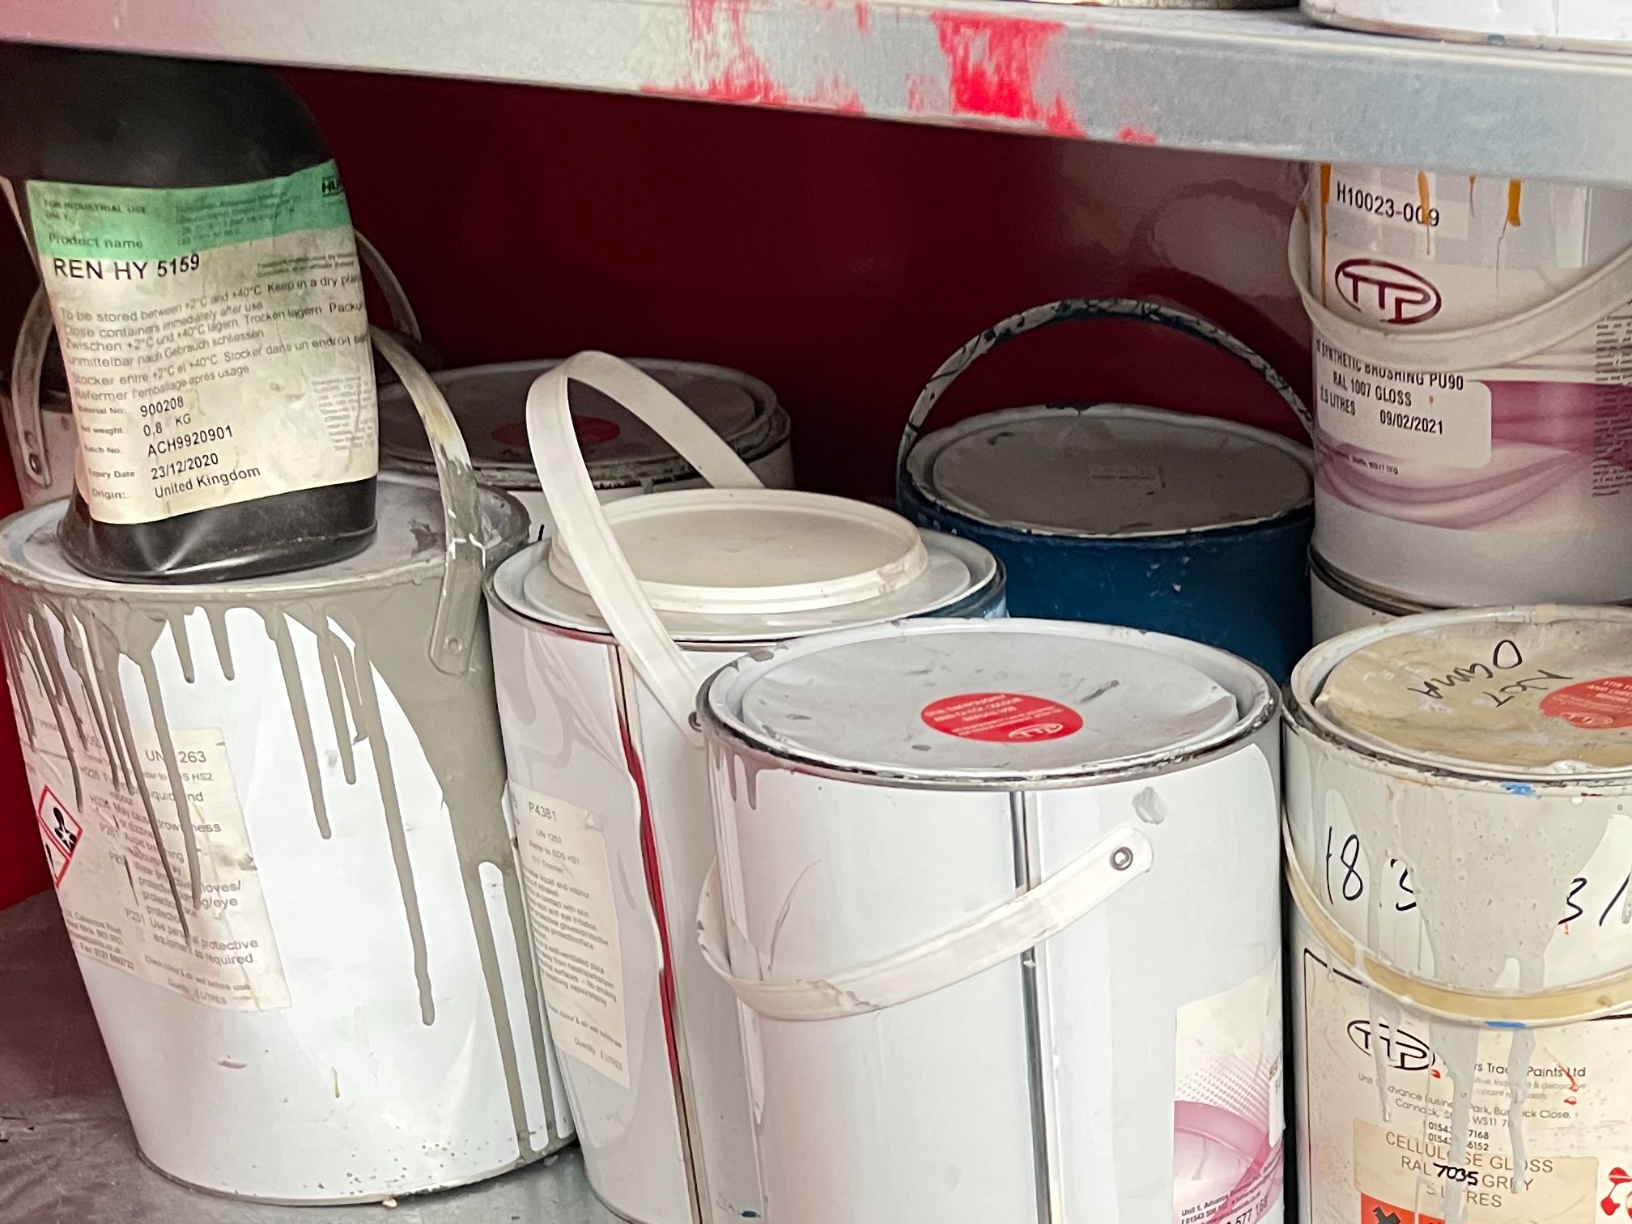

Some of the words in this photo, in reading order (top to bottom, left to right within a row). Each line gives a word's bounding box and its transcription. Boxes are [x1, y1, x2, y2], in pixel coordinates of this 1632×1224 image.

[49, 234, 102, 248] Product
[106, 239, 143, 249] name
[54, 258, 104, 279] REN
[115, 261, 148, 280] HY
[157, 253, 200, 277] 5159
[97, 312, 138, 321] stored
[141, 305, 182, 320] between
[211, 292, 229, 302] and
[268, 282, 295, 294] Keep
[297, 280, 307, 289] in
[320, 276, 337, 287] dry
[1340, 264, 1436, 323] TTP
[100, 322, 160, 338] containers
[221, 305, 242, 317] after
[244, 311, 285, 325] Trocken
[1333, 371, 1347, 391] RAL
[1351, 379, 1371, 398] 1007
[1375, 385, 1412, 407] GLOSS
[1429, 373, 1464, 391] PU90
[140, 395, 184, 417] 900208
[1330, 394, 1356, 416] LITRES
[175, 413, 192, 427] KG
[1380, 409, 1443, 435] 09/02/2021
[147, 425, 233, 458] ACH9920901
[151, 453, 219, 480] 23/12/2020
[155, 479, 193, 499] United
[197, 467, 262, 486] Kingdom
[1401, 1156, 1432, 1177] RAL
[1433, 1163, 1478, 1187] 7035
